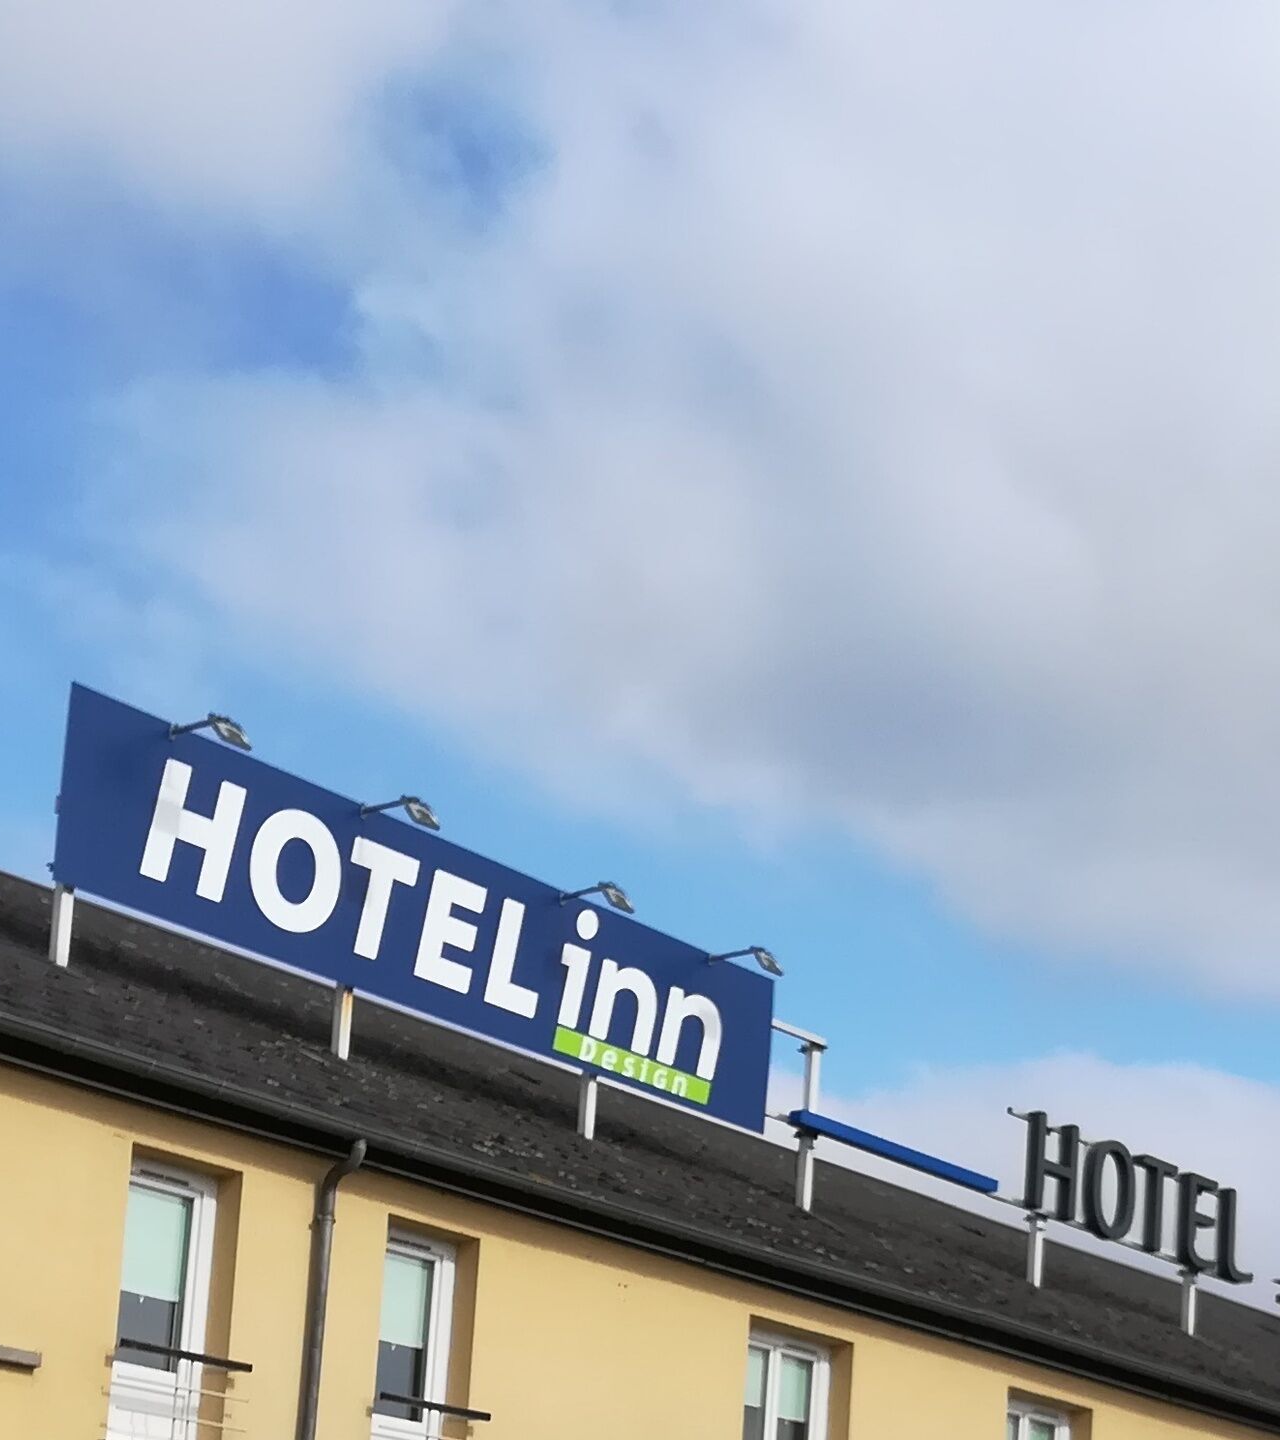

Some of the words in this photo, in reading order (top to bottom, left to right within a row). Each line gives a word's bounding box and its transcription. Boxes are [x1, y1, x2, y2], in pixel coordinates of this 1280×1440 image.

[139, 758, 540, 1019] HOTEL
[557, 908, 723, 1079] inn
[1023, 1111, 1254, 1283] HOTEL
